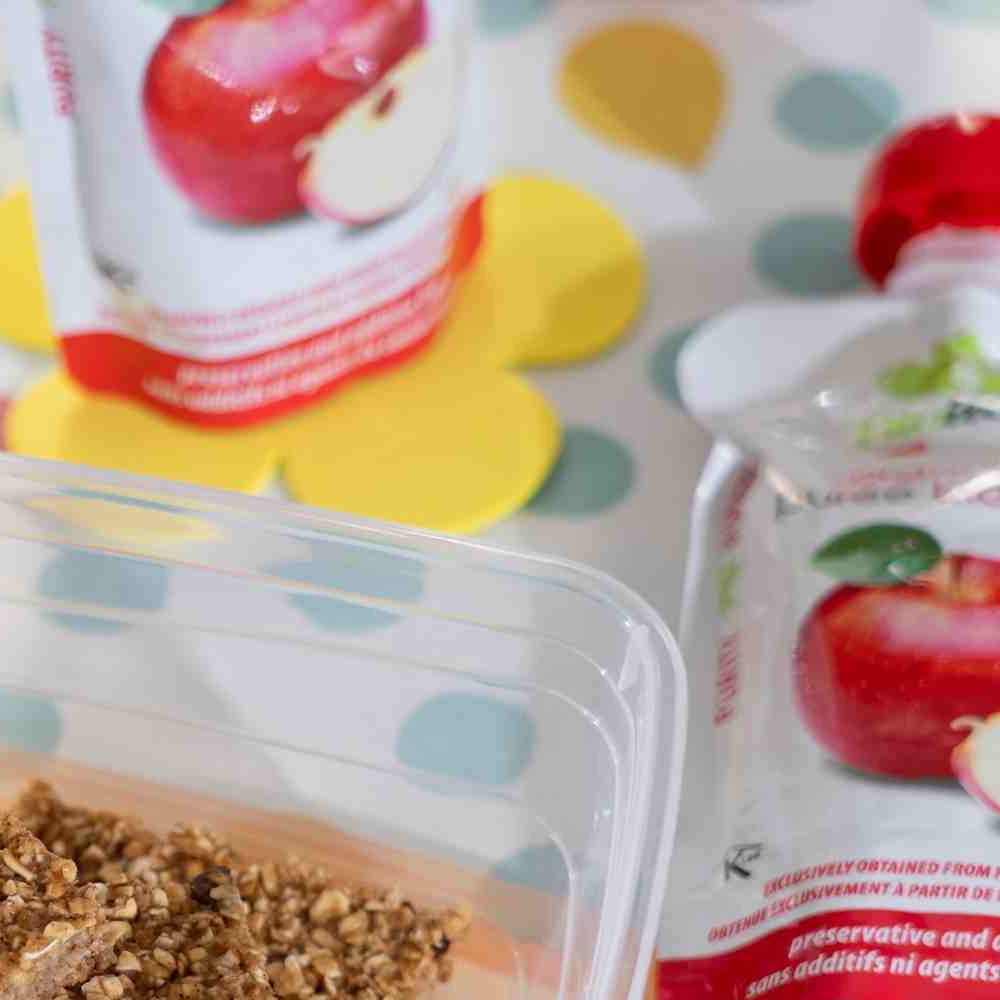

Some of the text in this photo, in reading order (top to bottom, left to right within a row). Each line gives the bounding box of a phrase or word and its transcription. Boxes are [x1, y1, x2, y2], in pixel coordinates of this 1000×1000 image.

[763, 861, 854, 897] EXCLUSIVELY
[856, 859, 939, 875] OBTAINED
[943, 863, 992, 878] FROM
[707, 907, 767, 942] OBTENUE
[768, 882, 890, 916] EXCLUSIVEMENT
[907, 883, 969, 899] PARTIR
[972, 886, 993, 901] DE
[788, 922, 937, 959] preservative
[940, 927, 989, 950] and
[745, 949, 1000, 1000] sans additifs ni agents
